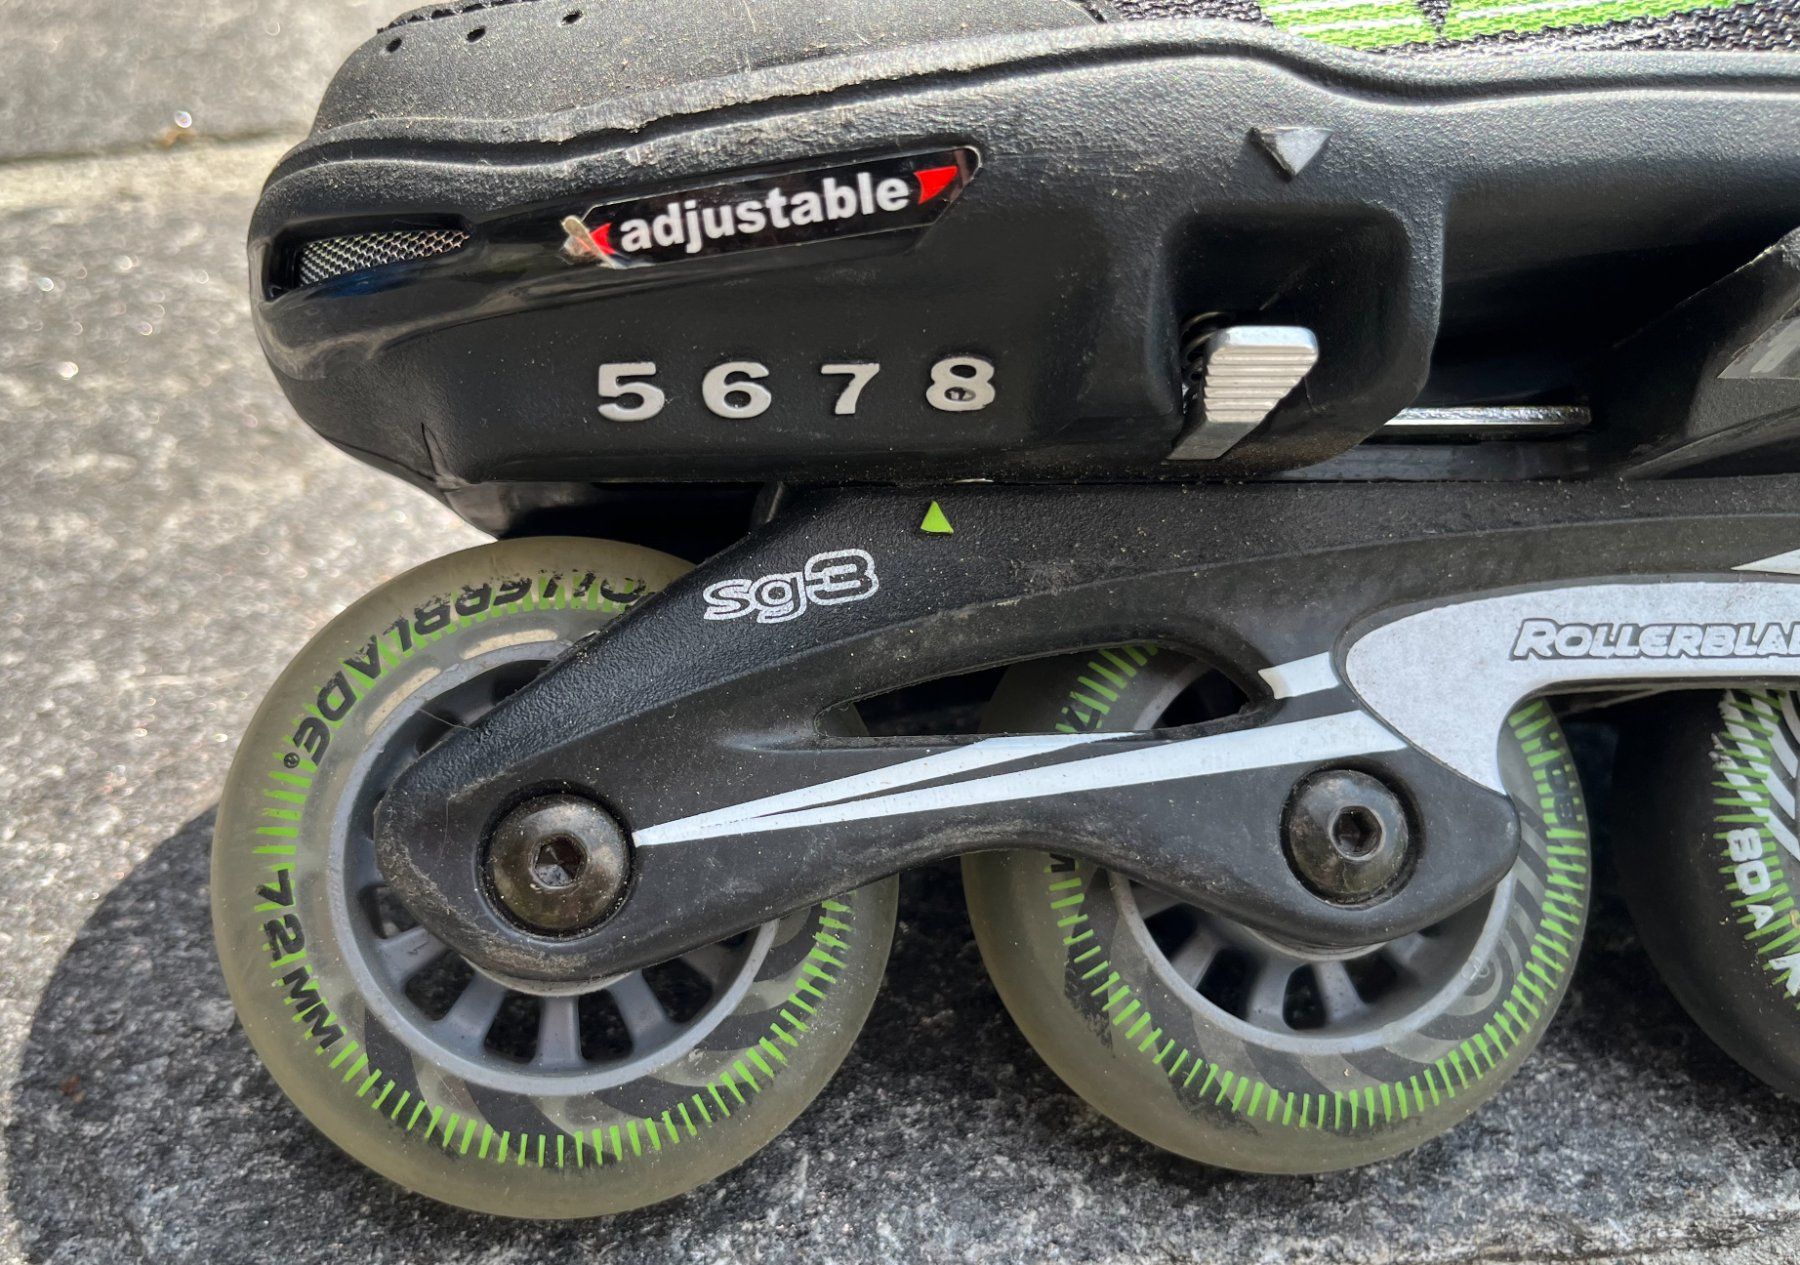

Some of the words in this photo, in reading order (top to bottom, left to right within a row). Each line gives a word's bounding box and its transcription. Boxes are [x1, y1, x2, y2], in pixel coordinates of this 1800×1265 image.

[620, 171, 912, 254] adjustable
[597, 361, 666, 422] 5
[702, 361, 772, 419] 6
[820, 362, 881, 415] 7
[926, 356, 996, 412] 8
[702, 548, 880, 624] sg3
[1726, 827, 1775, 930] 80A
